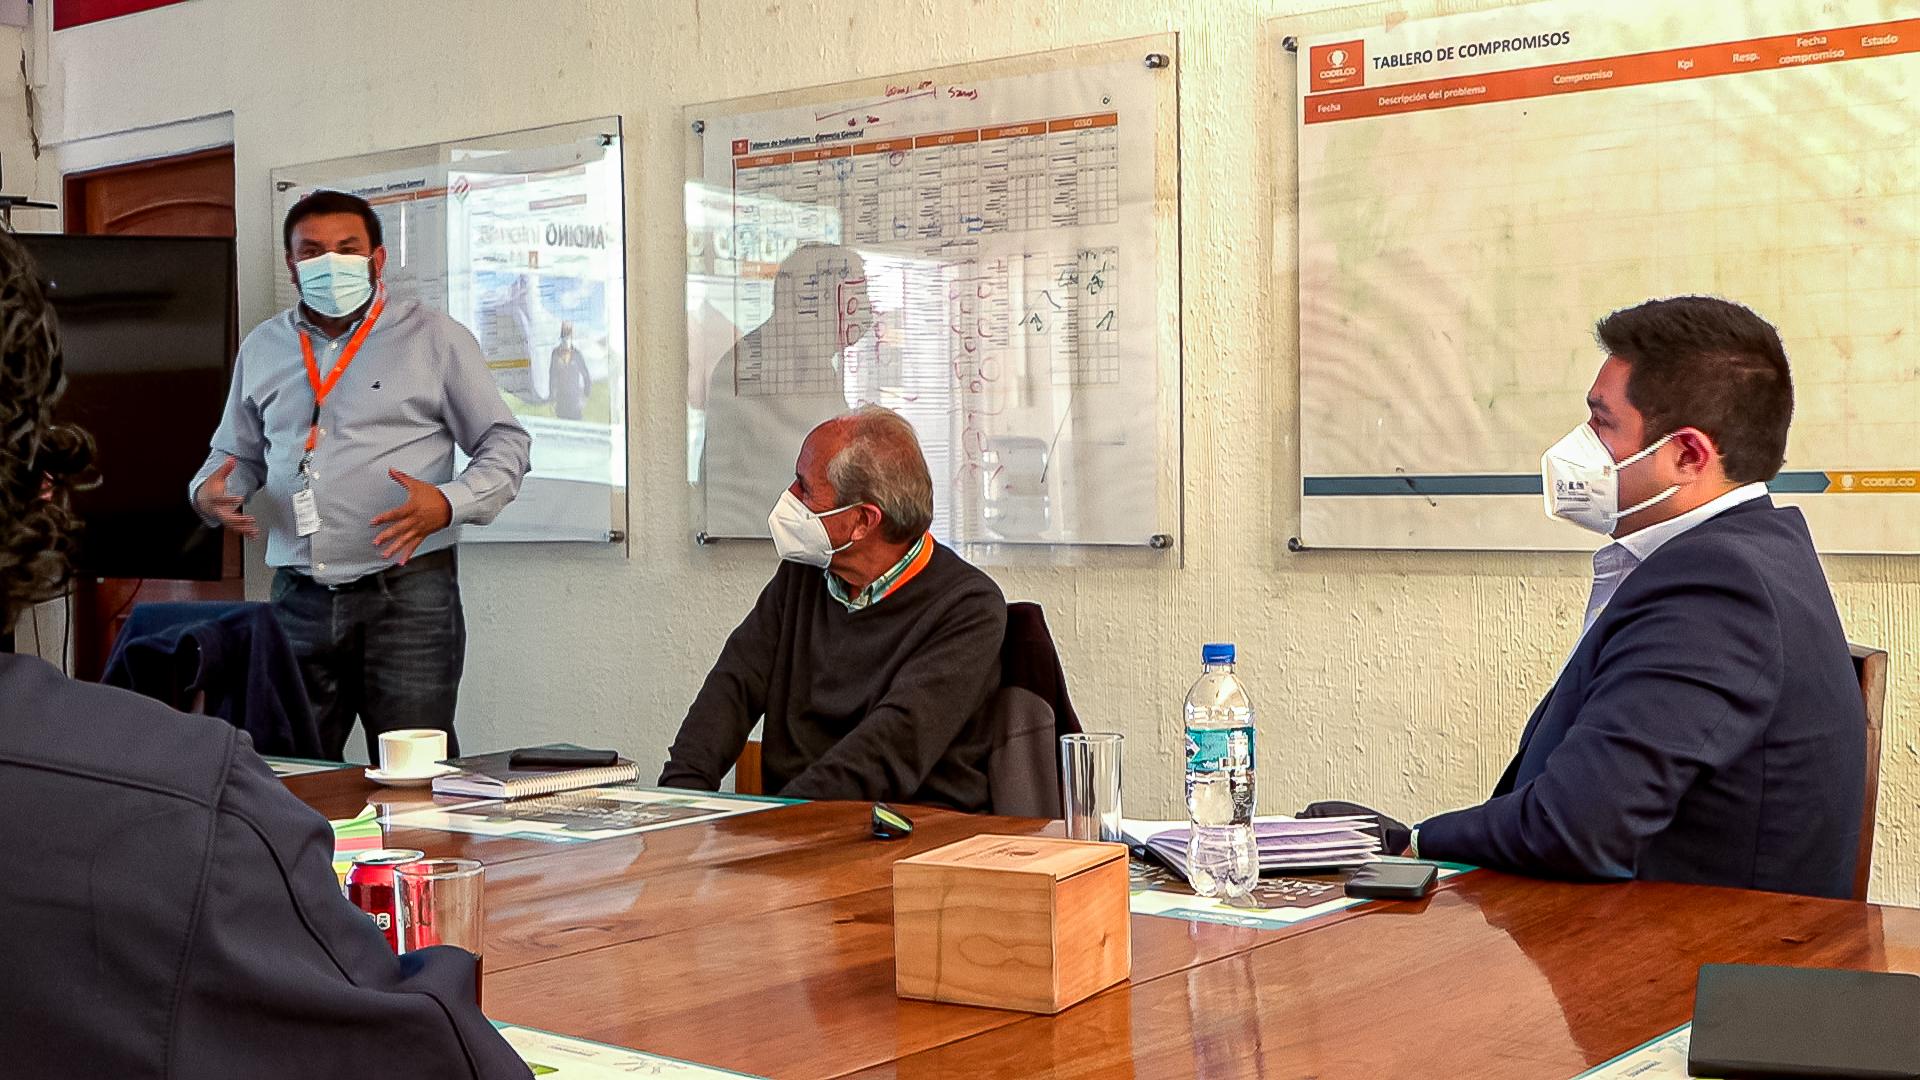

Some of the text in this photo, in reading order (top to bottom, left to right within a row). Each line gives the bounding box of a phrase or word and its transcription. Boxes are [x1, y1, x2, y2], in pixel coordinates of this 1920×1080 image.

[1796, 35, 1827, 48] Fecha
[1861, 33, 1899, 48] Estado
[1372, 30, 1571, 70] TABLERO DE COMPROMISOS
[1778, 48, 1846, 65] compromiso
[1677, 57, 1694, 71] Kpi
[1731, 51, 1761, 65] Resp.
[1319, 67, 1357, 79] CODELCO
[1552, 69, 1614, 85] Compromiso
[1378, 84, 1487, 107] Descripción del problema
[1317, 102, 1341, 114] Fecha
[1860, 476, 1917, 488] CODELCO
